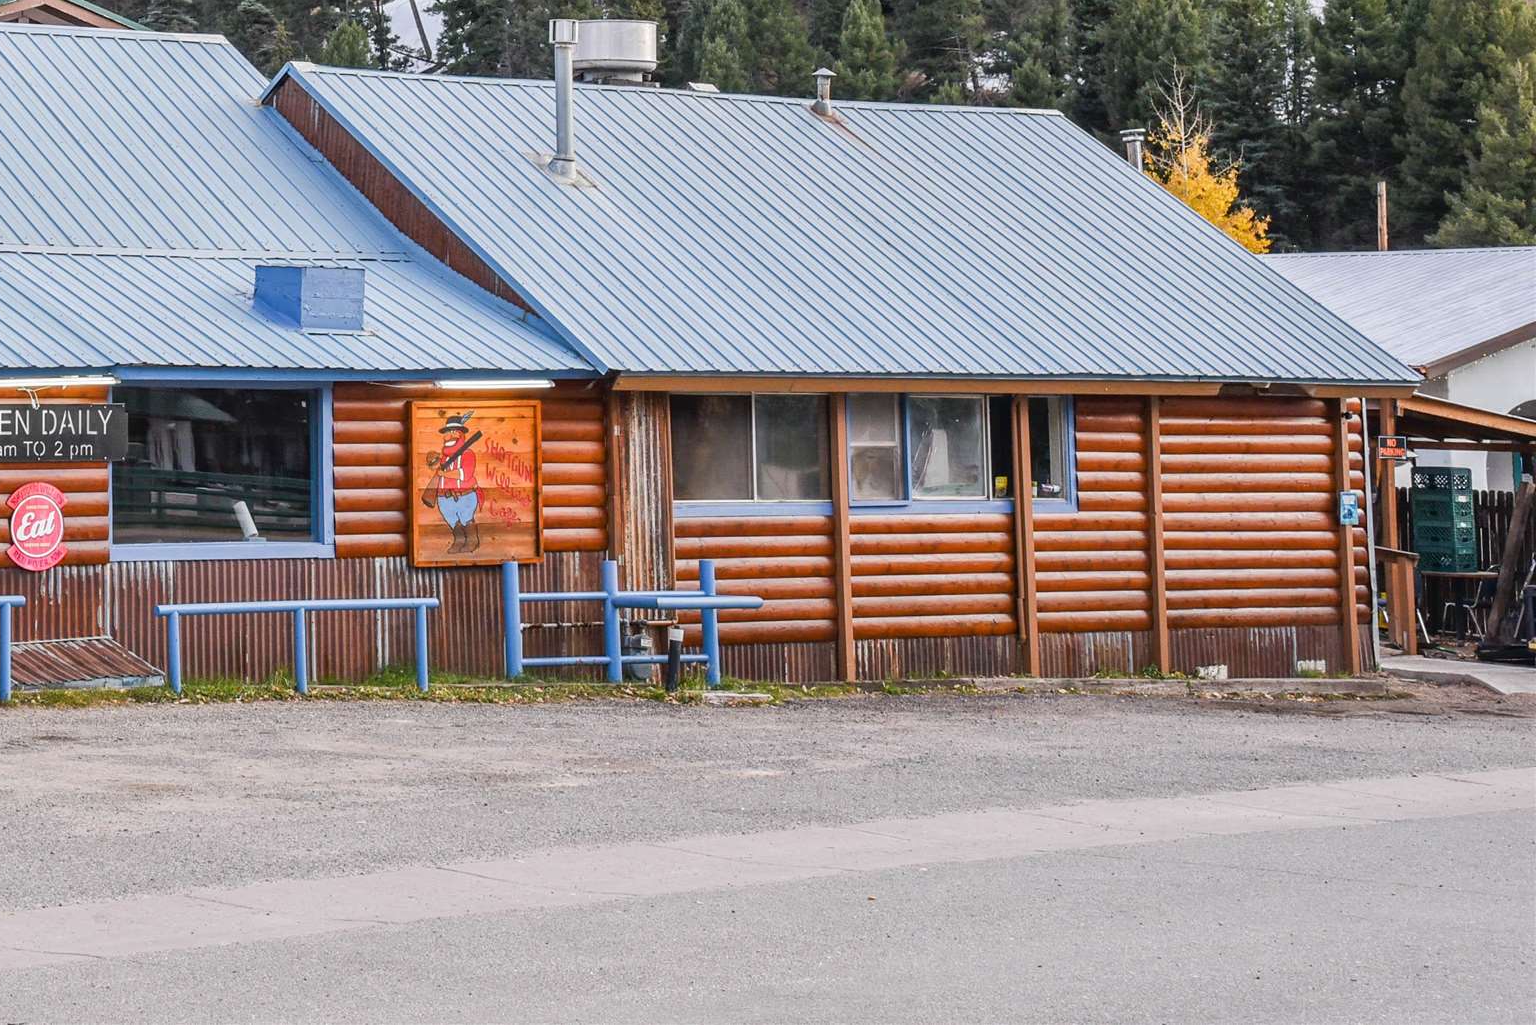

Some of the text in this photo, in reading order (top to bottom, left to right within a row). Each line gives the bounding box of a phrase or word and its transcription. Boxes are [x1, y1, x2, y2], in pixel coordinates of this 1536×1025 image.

[42, 409, 113, 436] DAILY
[23, 441, 46, 457] TO
[54, 441, 64, 457] 2
[69, 443, 93, 460] pm
[1379, 446, 1406, 458] PARKING
[1386, 438, 1397, 448] NO
[484, 436, 532, 484] SHOTGUN
[16, 510, 56, 542] Eat
